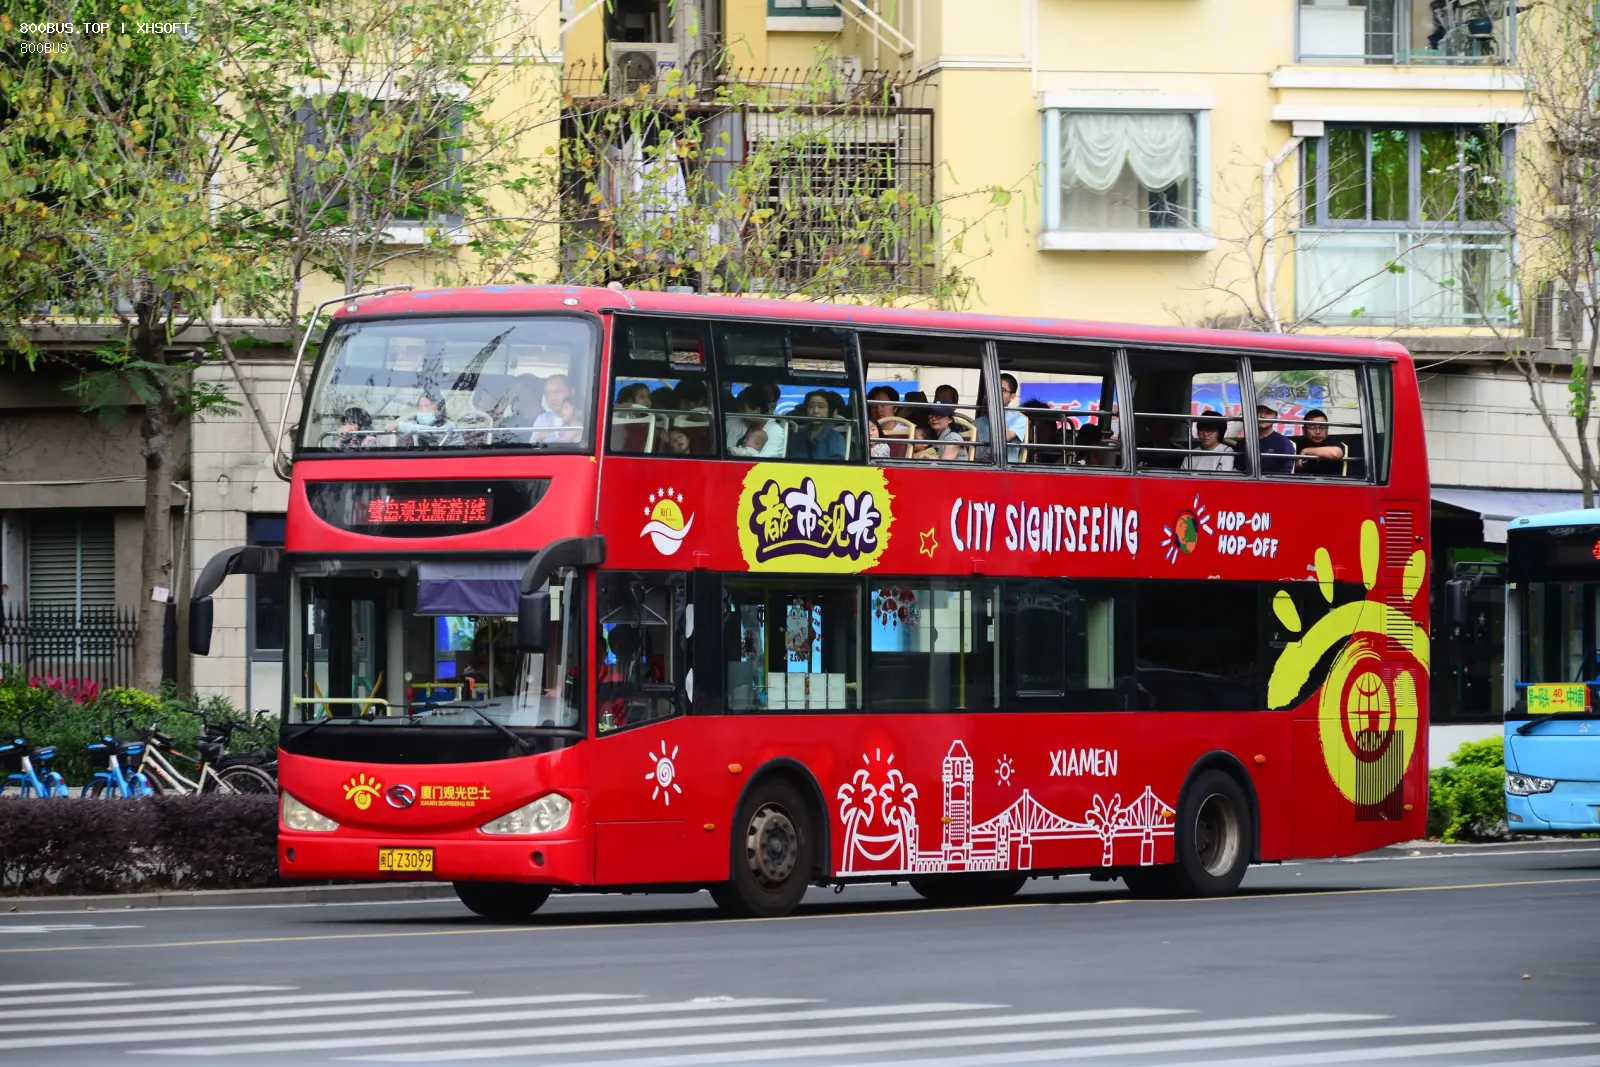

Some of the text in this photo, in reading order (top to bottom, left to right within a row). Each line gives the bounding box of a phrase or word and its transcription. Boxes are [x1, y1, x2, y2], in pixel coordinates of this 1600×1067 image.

[755, 479, 881, 553] 都市观光
[950, 496, 1140, 557] CITY SIGHTSEEING
[1216, 510, 1272, 532] HOP-ON
[1217, 534, 1279, 559] HOP-OFF
[1552, 688, 1563, 698] 40
[1049, 748, 1118, 777] XIAMEN
[420, 785, 491, 800] 厦门观光巴士
